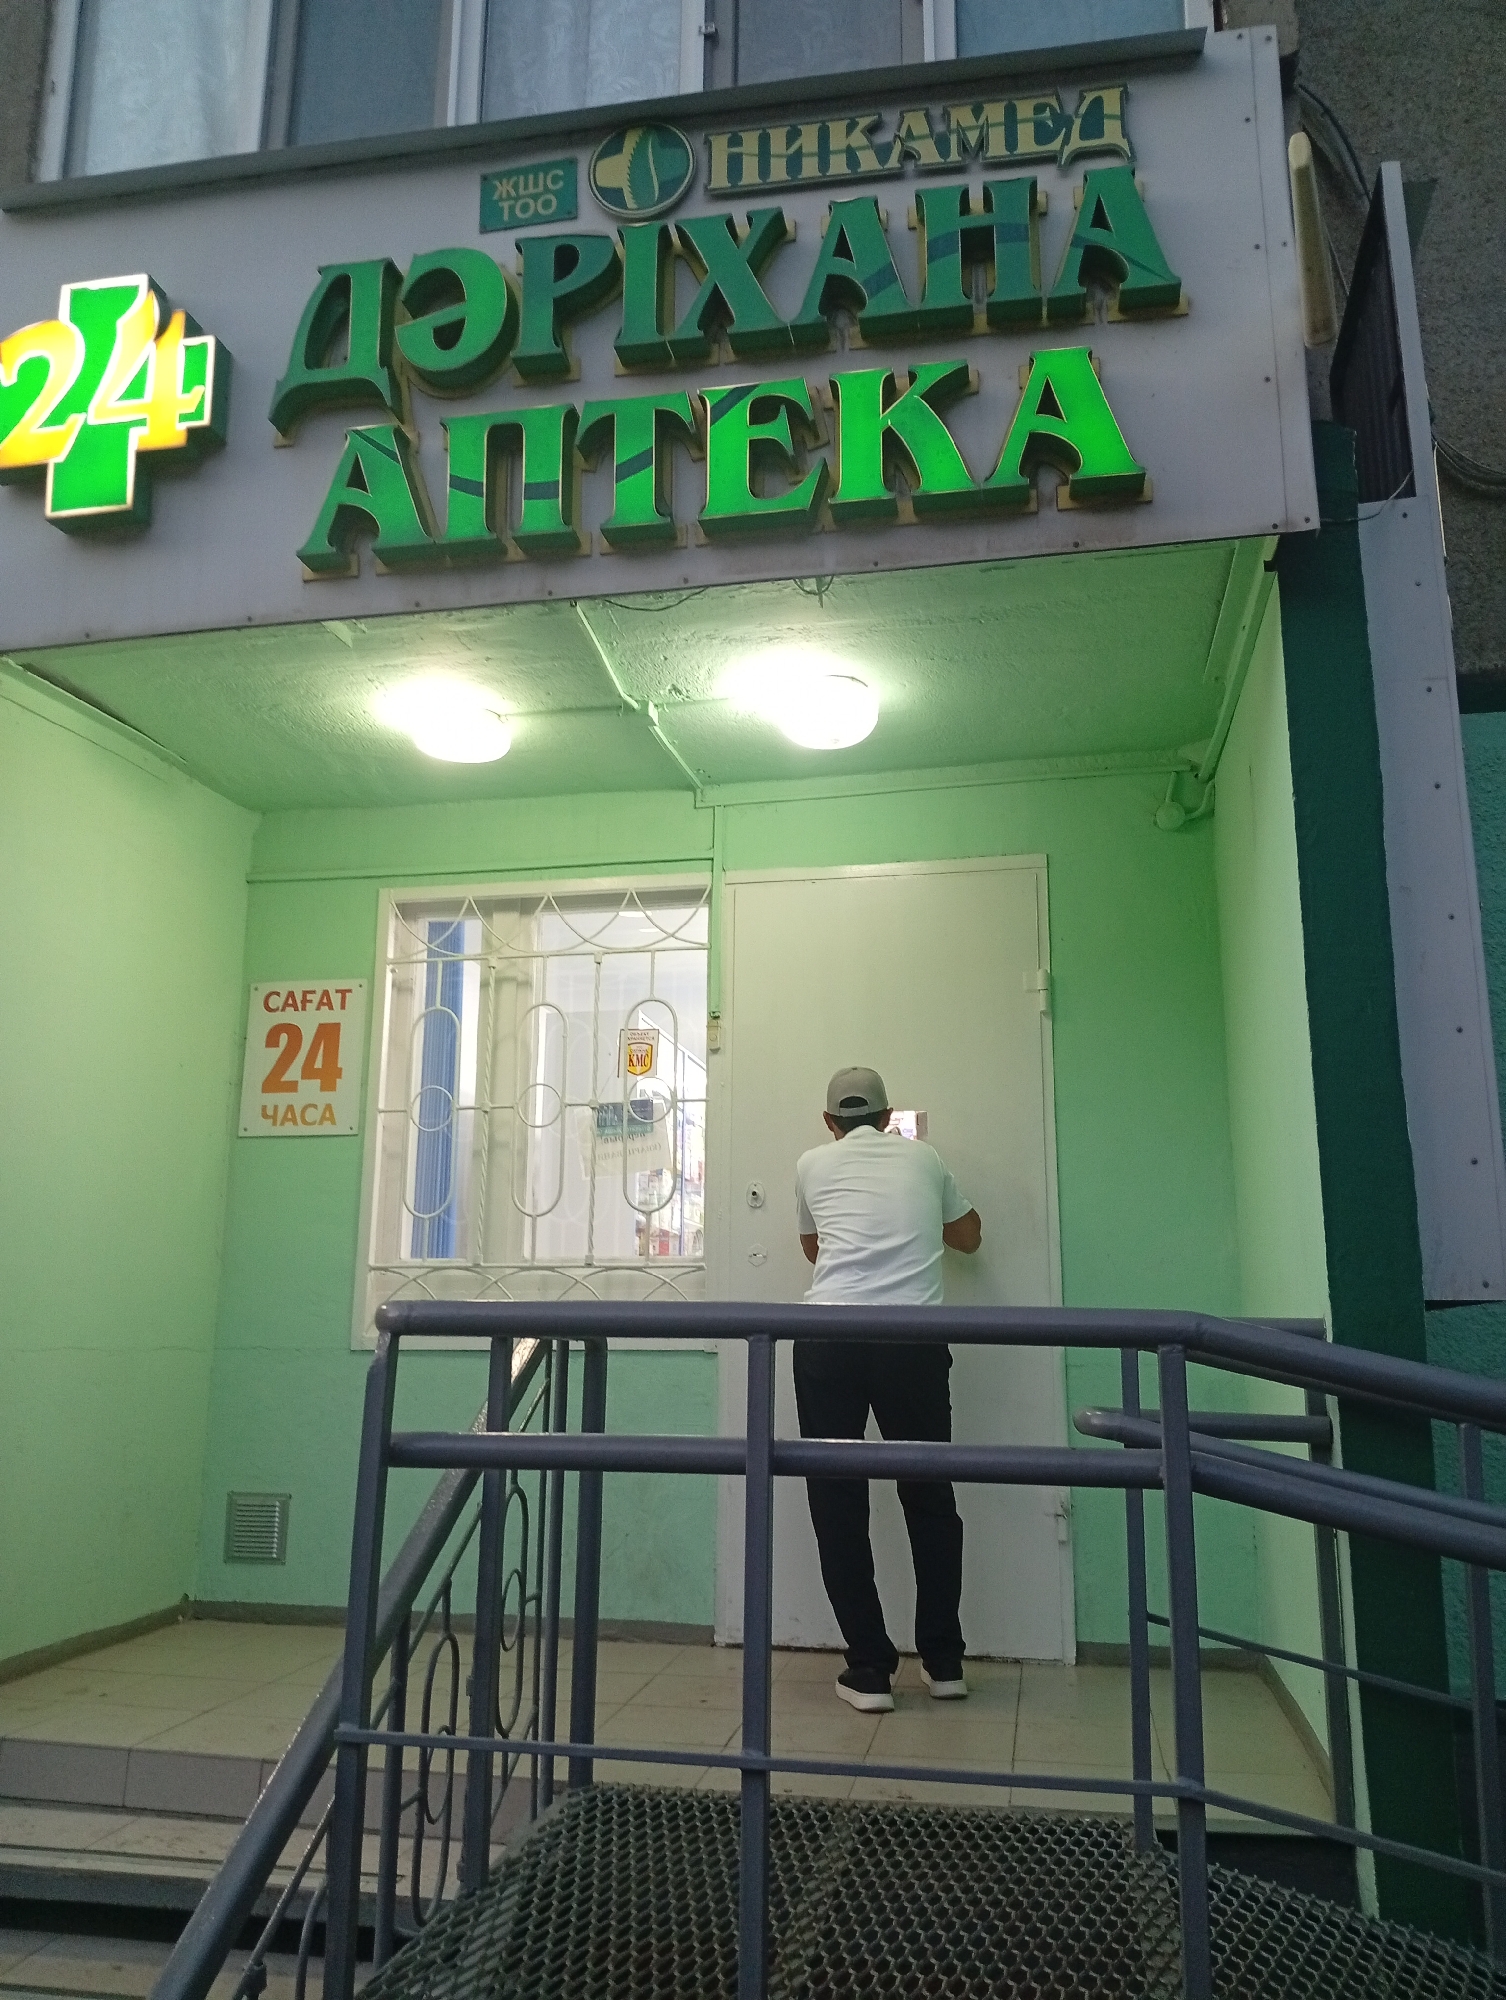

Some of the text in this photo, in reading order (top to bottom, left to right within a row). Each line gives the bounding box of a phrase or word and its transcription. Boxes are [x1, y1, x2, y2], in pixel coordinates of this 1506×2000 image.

[704, 86, 1134, 191] НИКАМЕД
[492, 169, 564, 201] ЖШС
[499, 194, 557, 222] ТОО
[269, 166, 1182, 432] ДӘРІХАНА
[0, 288, 206, 468] 24
[297, 346, 1146, 573] АПТЕКА
[263, 988, 353, 1013] САҒАТ
[261, 1022, 343, 1094] 24
[628, 1053, 649, 1067] КМС
[261, 1103, 336, 1126] ЧАСА
